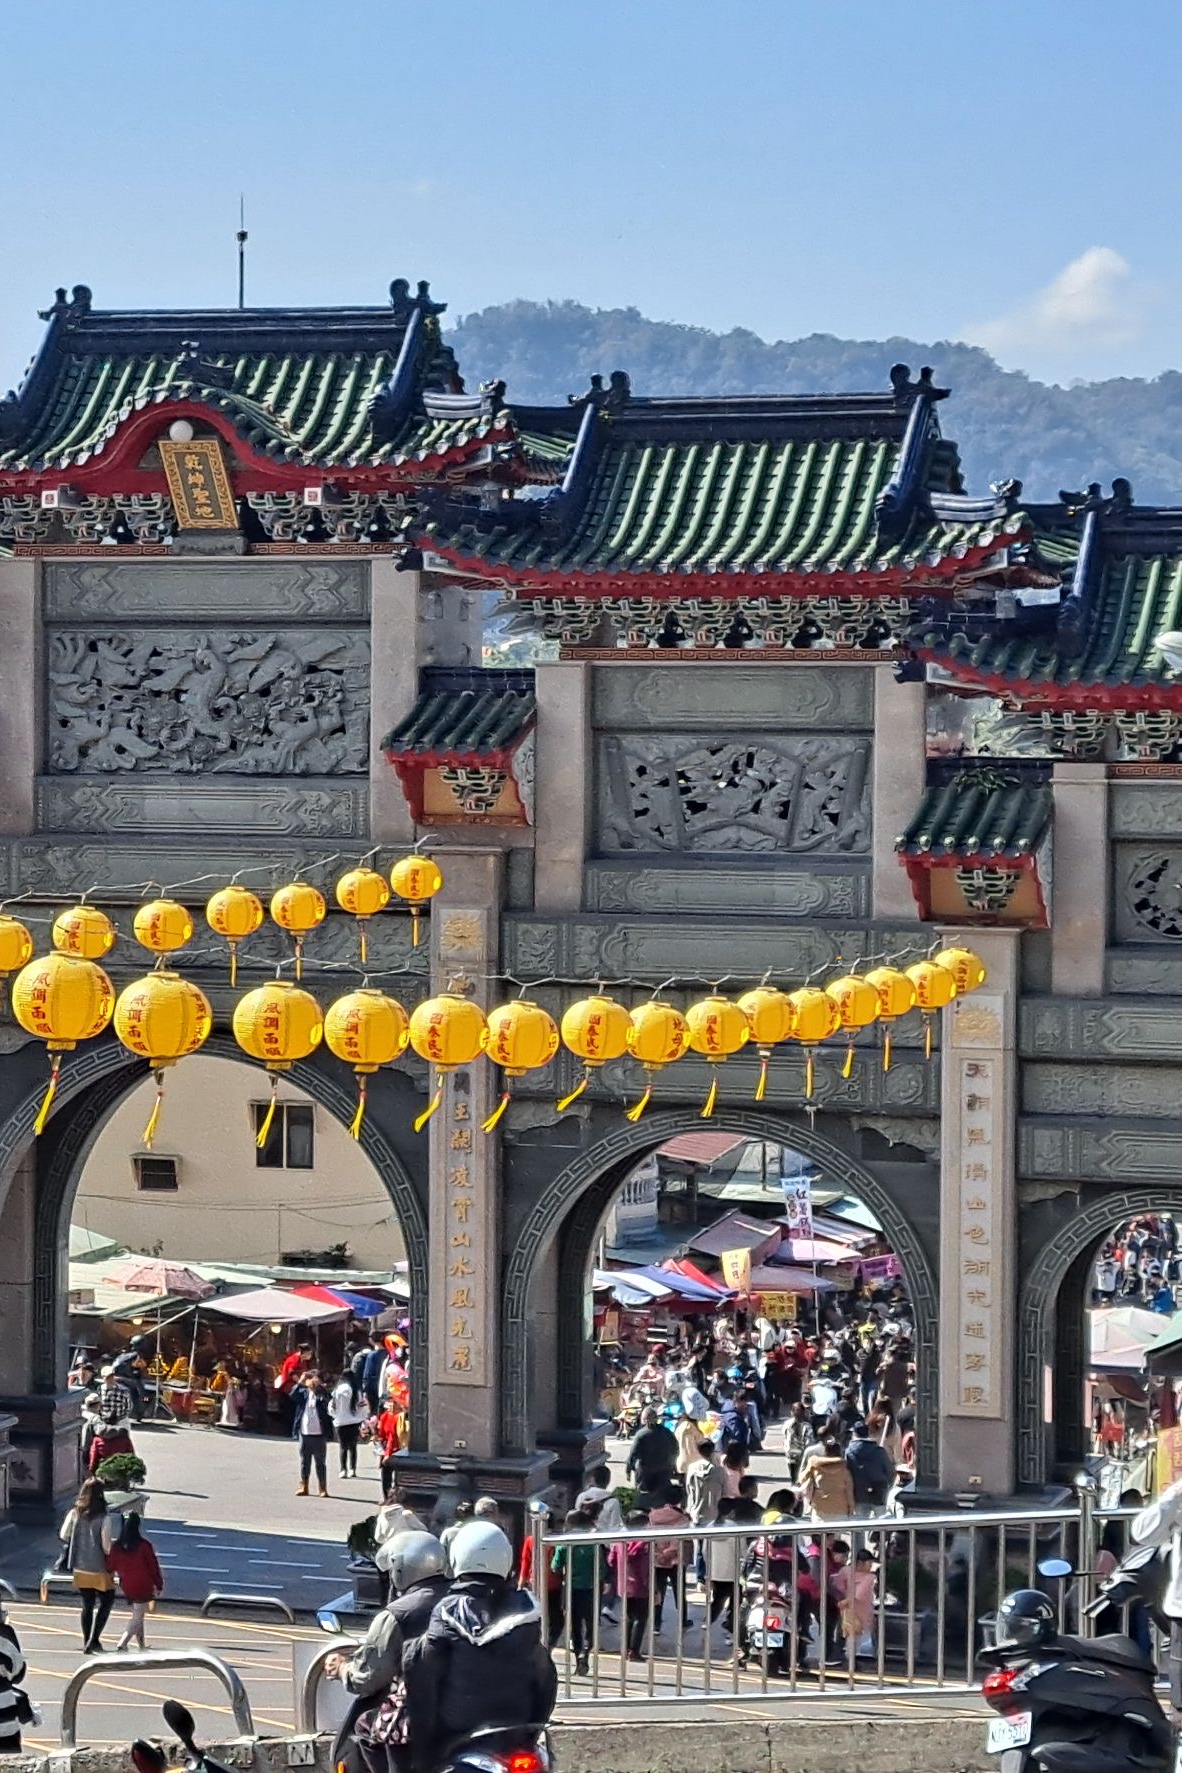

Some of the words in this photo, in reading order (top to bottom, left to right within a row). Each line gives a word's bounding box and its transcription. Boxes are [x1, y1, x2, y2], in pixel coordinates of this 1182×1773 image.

[68, 921, 81, 951] 國泰民
[263, 1002, 282, 1057] 風調雨順
[344, 1009, 362, 1059] 風調雨順
